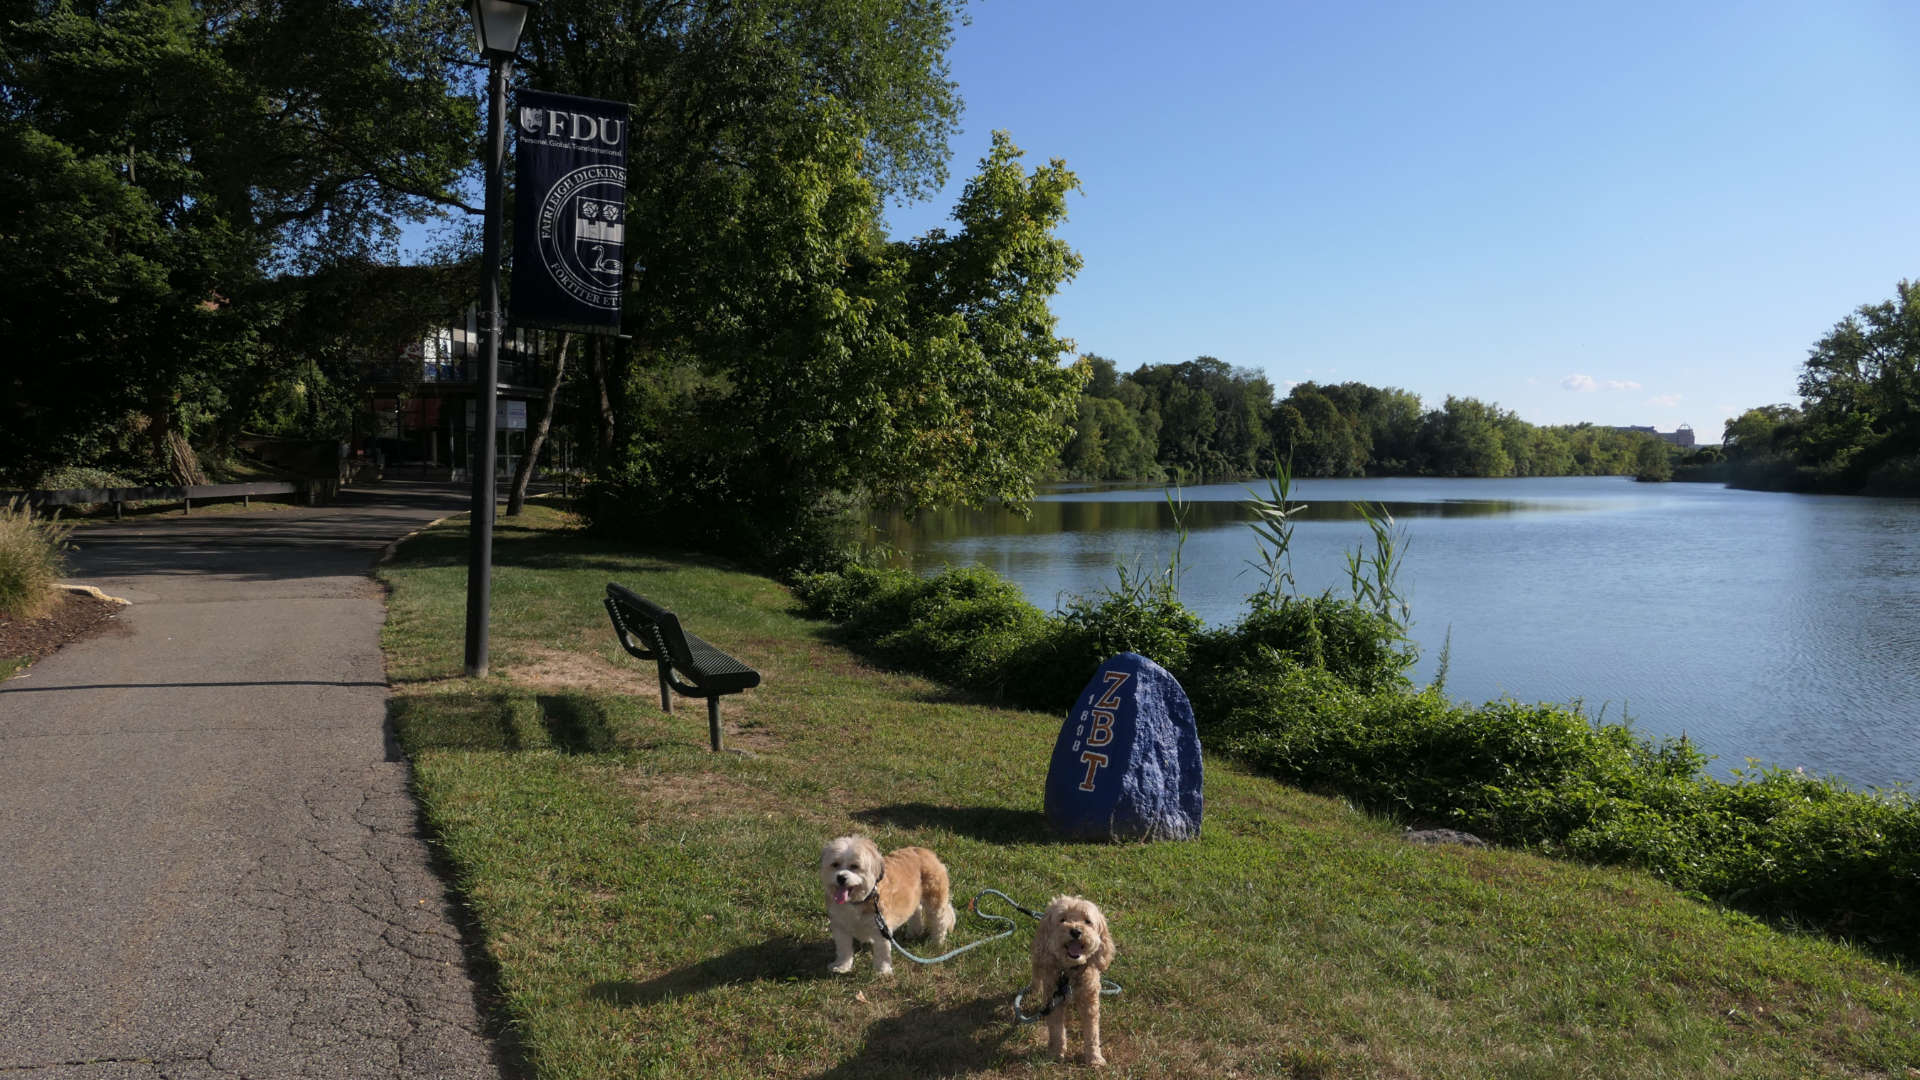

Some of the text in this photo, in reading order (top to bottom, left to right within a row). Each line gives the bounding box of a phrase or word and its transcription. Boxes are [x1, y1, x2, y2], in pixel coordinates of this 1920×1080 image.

[546, 109, 624, 145] FDU
[541, 168, 627, 239] FAIRLEIGH DICKINS
[550, 262, 618, 306] FORTITER ET
